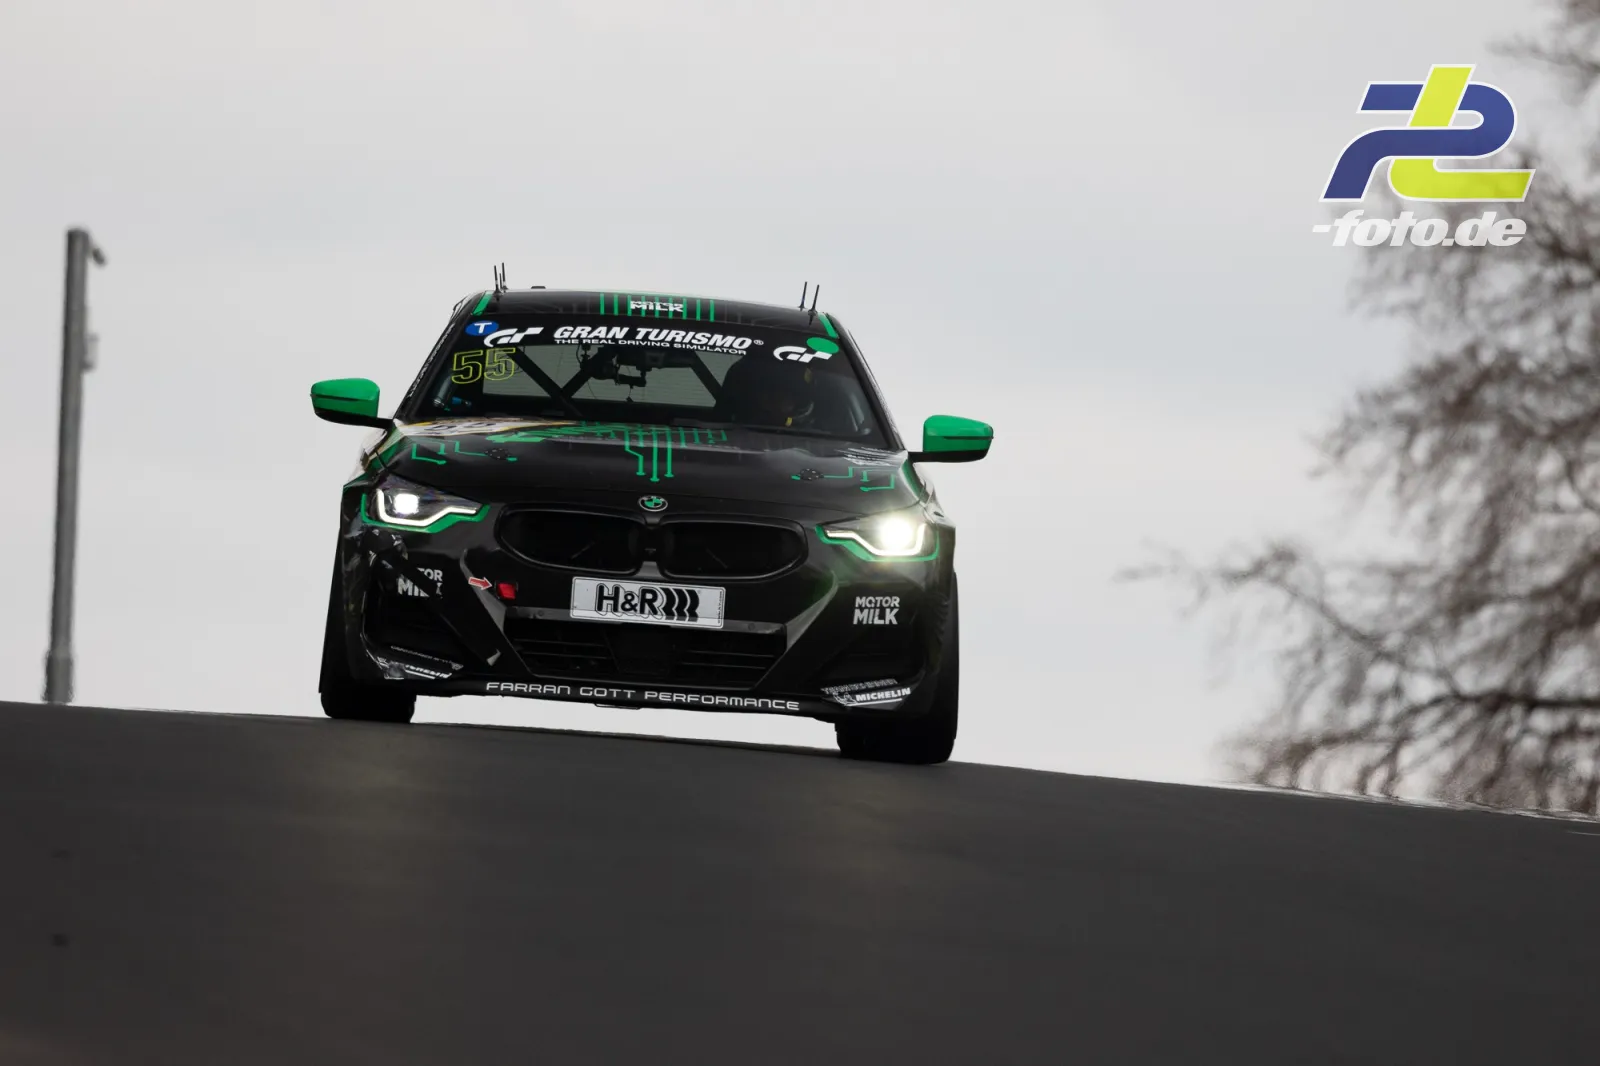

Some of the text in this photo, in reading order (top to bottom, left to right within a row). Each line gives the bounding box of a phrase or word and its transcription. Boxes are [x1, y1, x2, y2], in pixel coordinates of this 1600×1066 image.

[553, 326, 630, 339] GRAN
[673, 342, 747, 355] SIMULATOR
[451, 347, 516, 384] 55
[596, 583, 664, 619] H&R
[855, 596, 900, 607] MOTOR
[853, 608, 899, 625] MILK
[486, 682, 800, 711] FARRAN GOTT PERFORMANCE
[855, 687, 911, 702] MICHELIN
